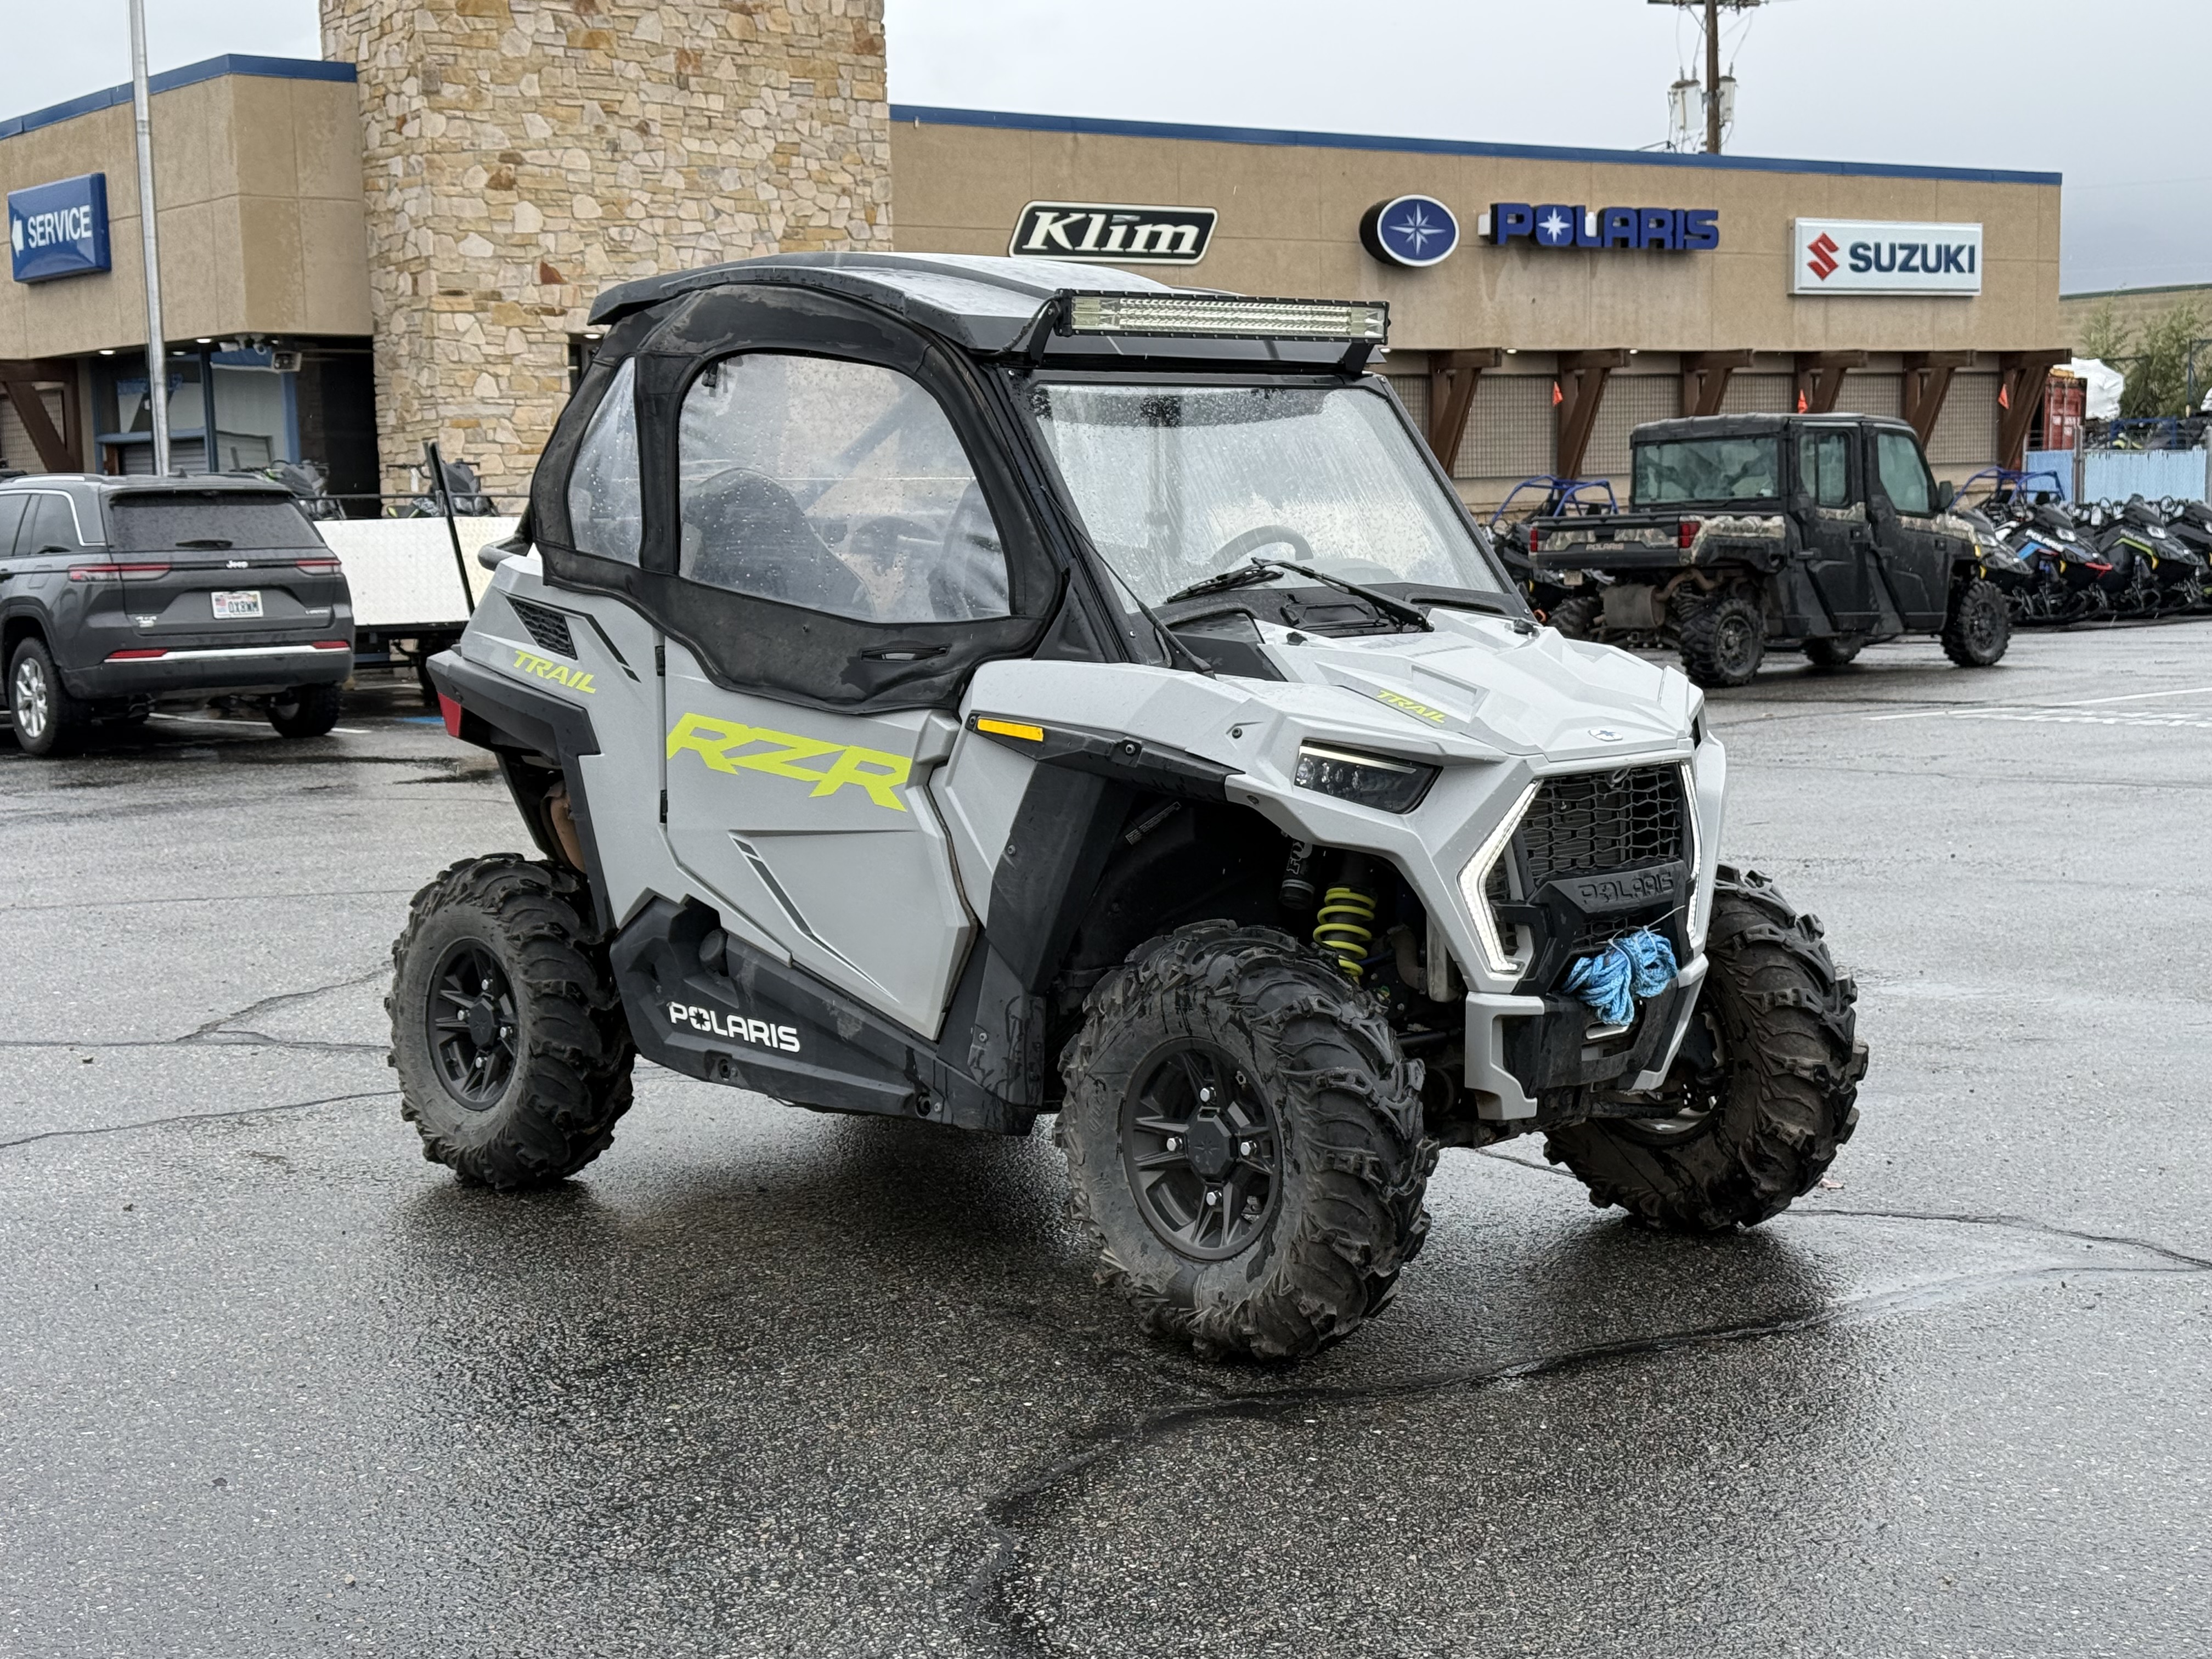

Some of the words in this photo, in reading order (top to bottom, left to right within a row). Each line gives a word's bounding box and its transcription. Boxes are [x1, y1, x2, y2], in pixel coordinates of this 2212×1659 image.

[28, 205, 92, 249] SERVICE
[1022, 211, 1200, 254] Klim
[1496, 203, 1719, 250] POLARIS
[1849, 241, 1975, 274] SUZUKI
[225, 560, 249, 569] Jeep
[1585, 542, 1624, 551] POLARIS
[514, 650, 596, 694] TRAIL
[1376, 690, 1445, 724] TRAIL
[667, 712, 912, 812] RZR
[1577, 871, 1674, 904] POLARIS
[667, 1001, 800, 1053] POLARIS
